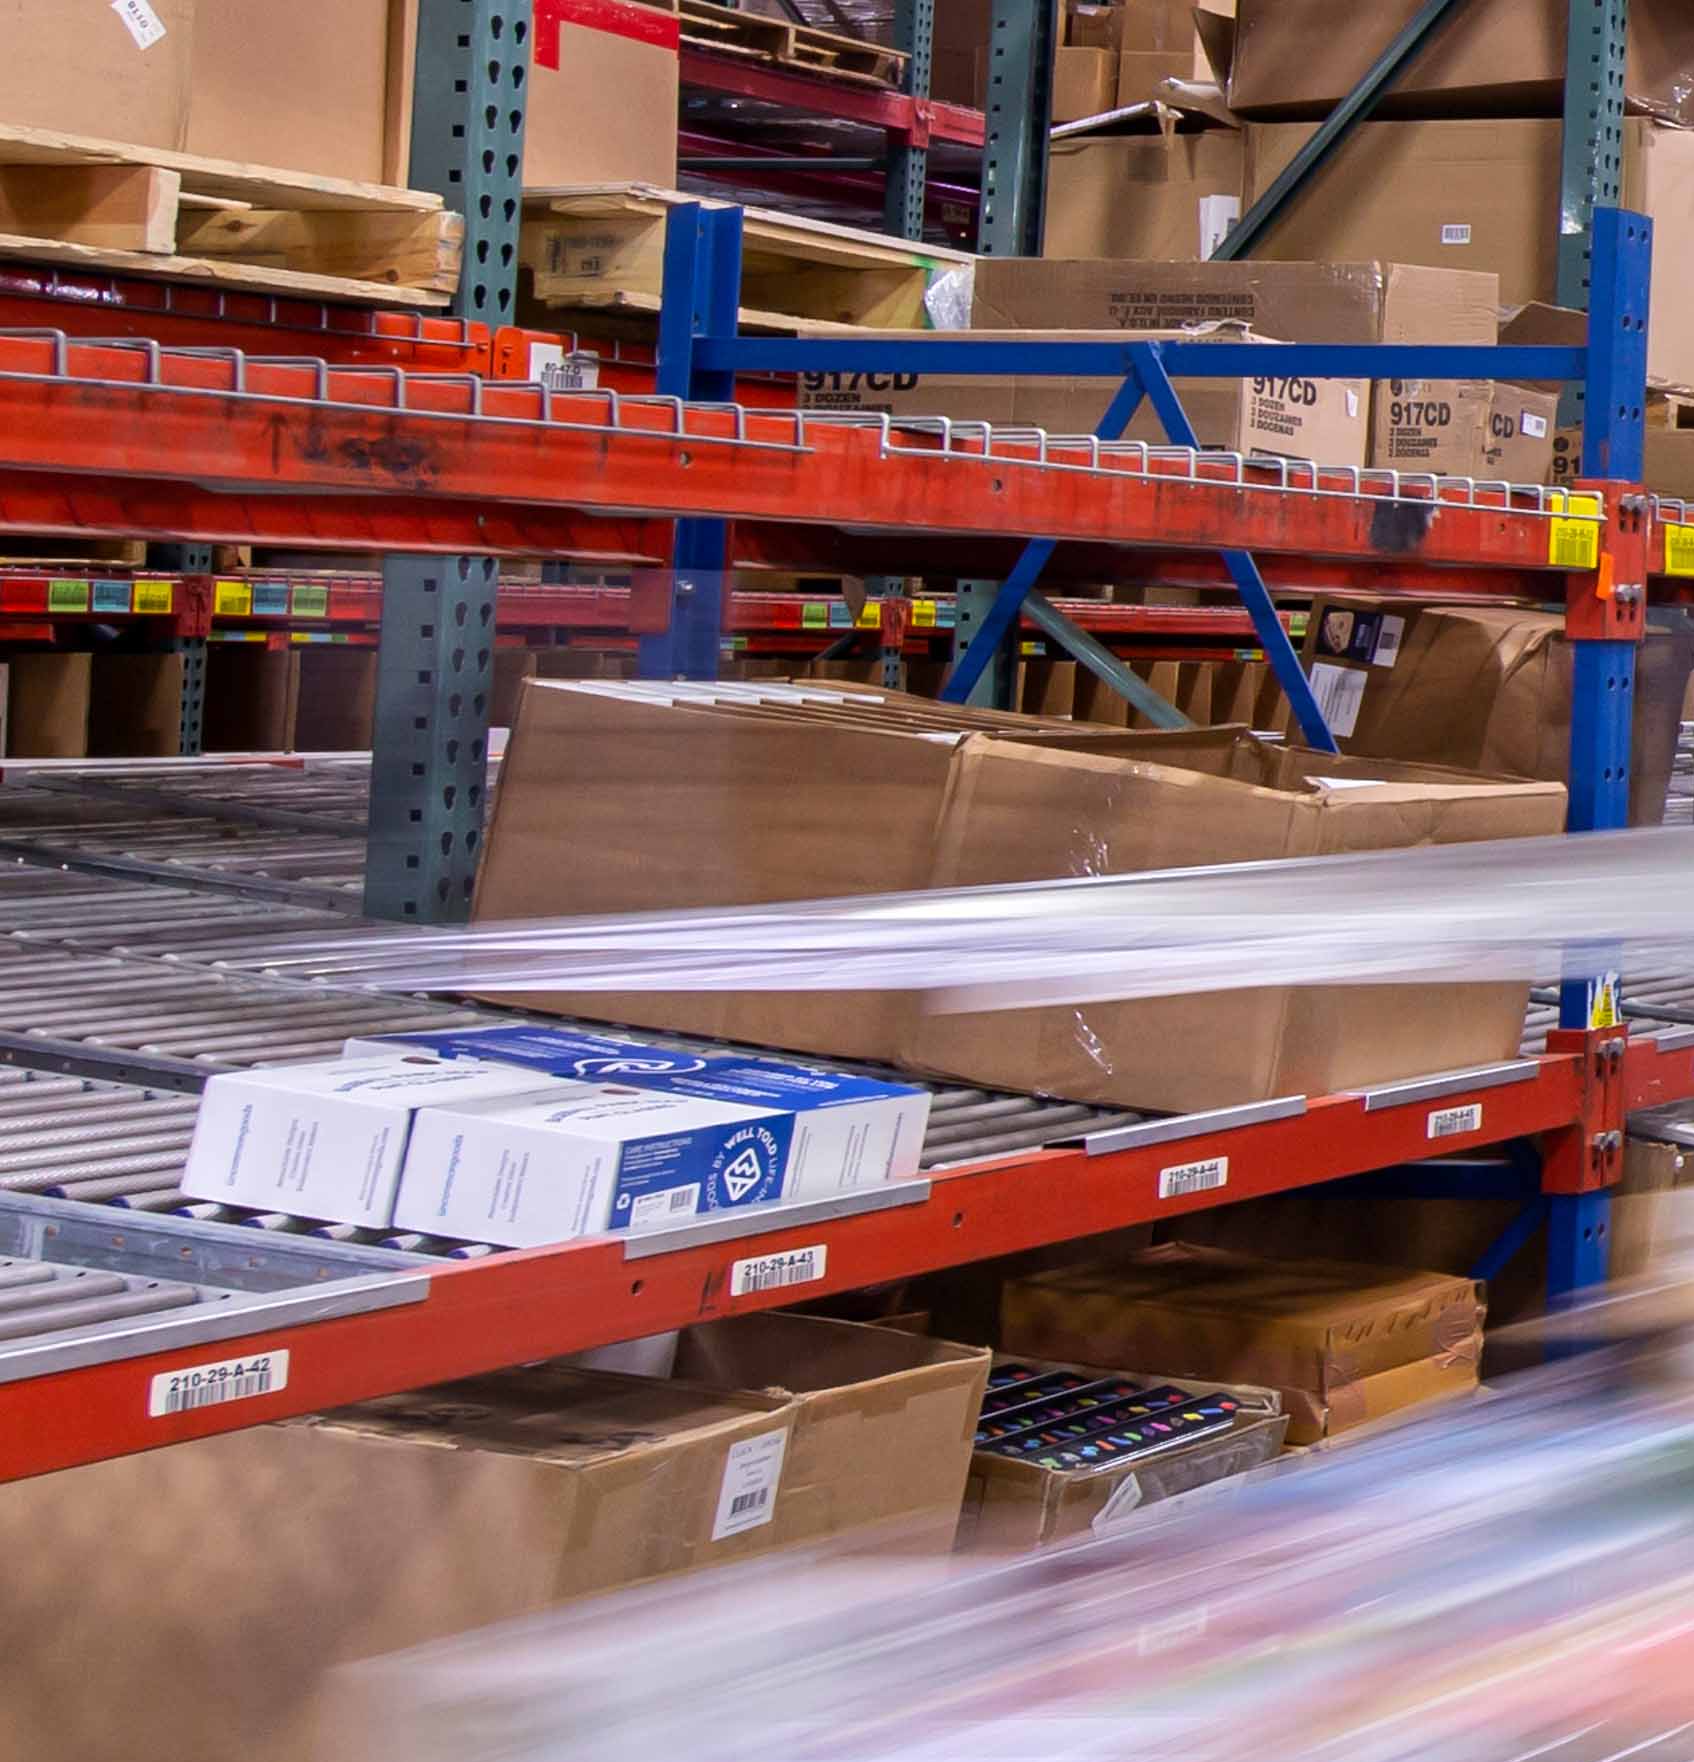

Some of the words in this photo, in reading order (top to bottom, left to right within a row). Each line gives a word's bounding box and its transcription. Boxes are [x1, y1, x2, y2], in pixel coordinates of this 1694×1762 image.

[803, 371, 918, 392] 917CD
[1253, 376, 1317, 406] 917CD
[1390, 402, 1451, 427] 917CD
[724, 1127, 755, 1150] WELL
[757, 1127, 778, 1155] TOLD
[744, 1251, 814, 1277] 210-29-A-43
[170, 1356, 272, 1391] 210-29-A-42
